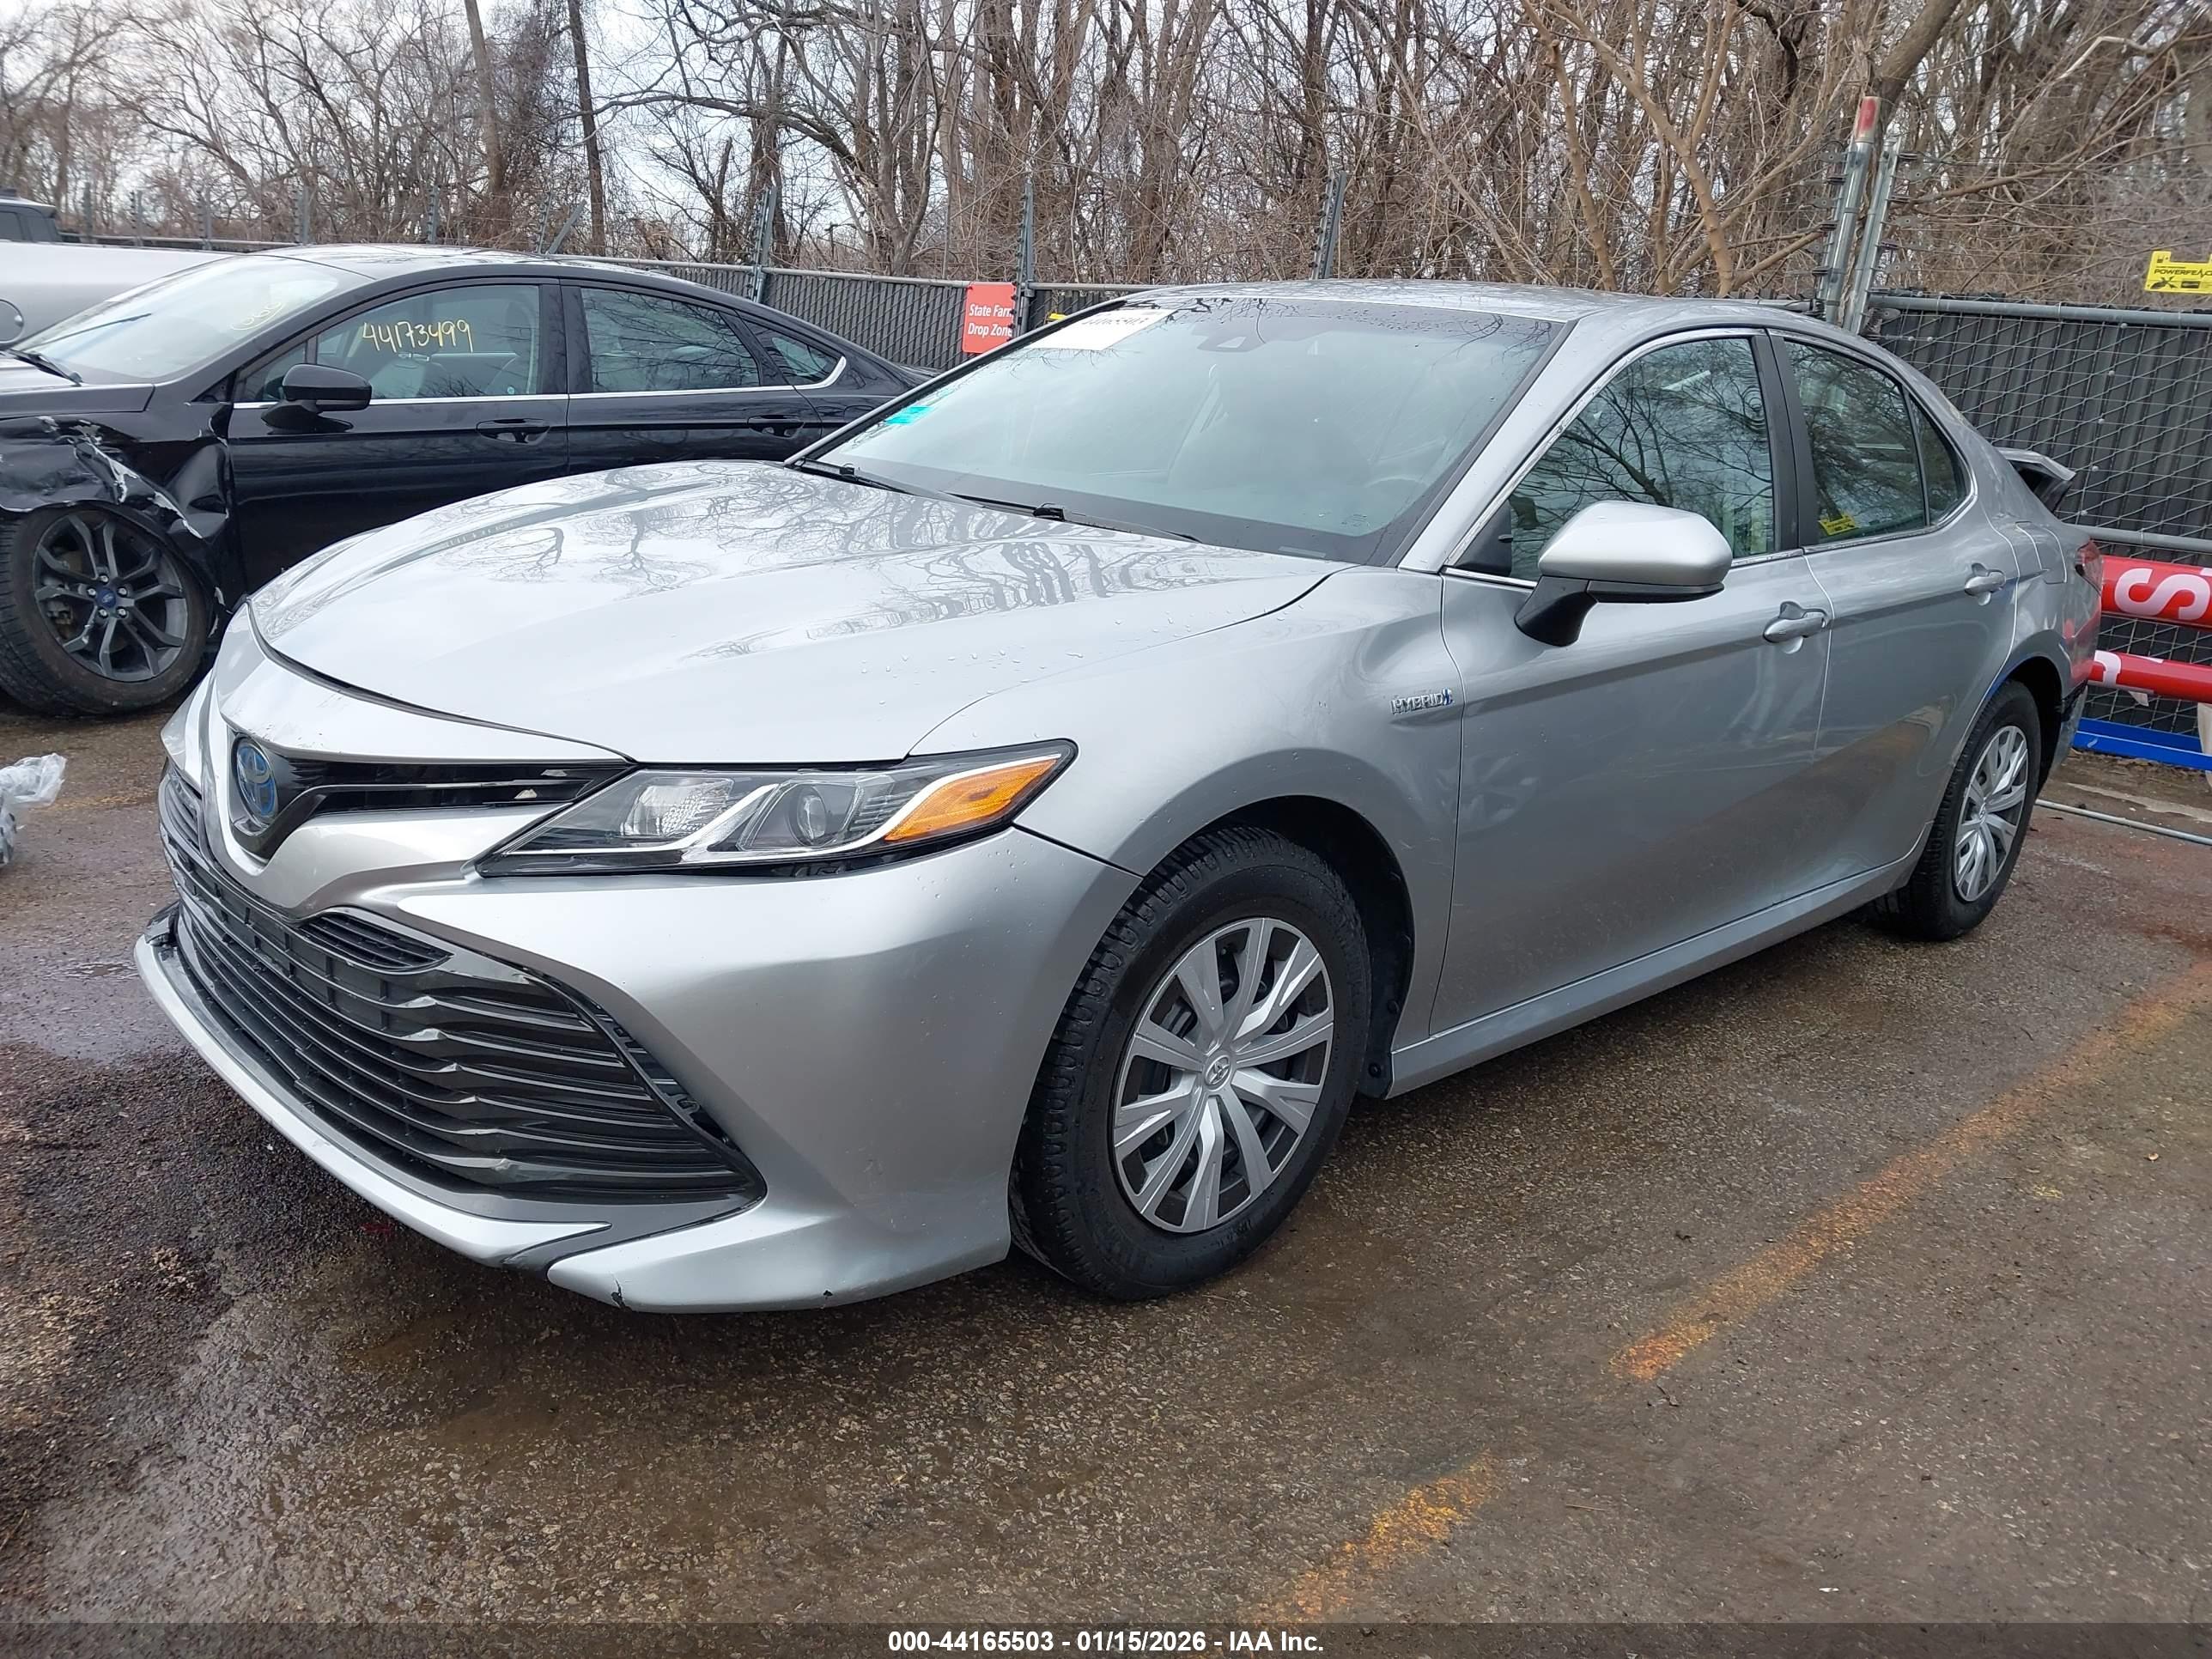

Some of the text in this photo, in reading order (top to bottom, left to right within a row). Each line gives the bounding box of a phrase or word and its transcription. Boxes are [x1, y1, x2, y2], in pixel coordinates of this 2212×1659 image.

[2154, 269, 2212, 277] POWERFENC
[969, 303, 991, 316] State
[362, 319, 474, 353] 44173499
[968, 322, 1012, 337] Drop Zone
[1391, 693, 1443, 714] HYBRID
